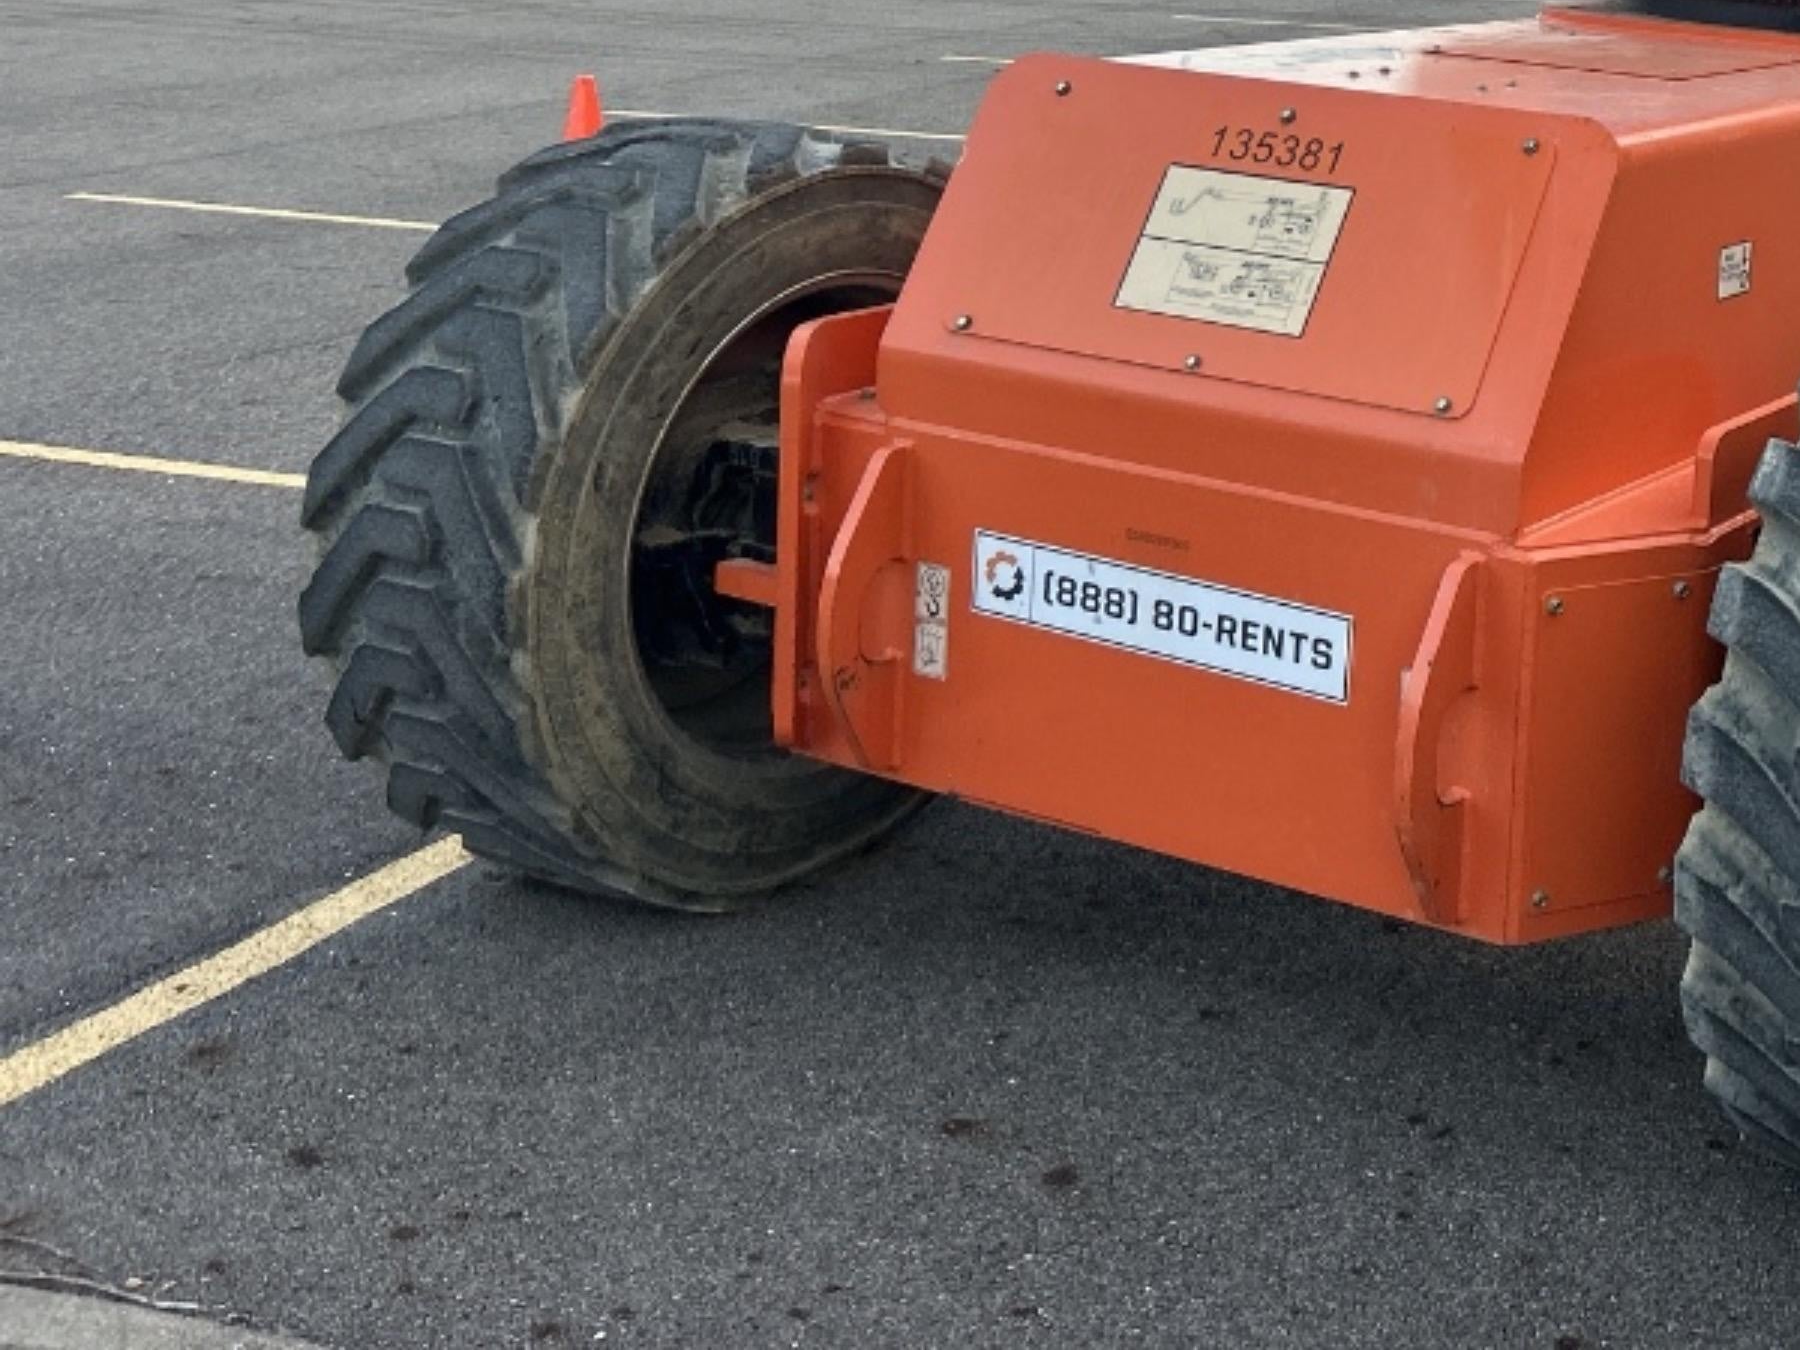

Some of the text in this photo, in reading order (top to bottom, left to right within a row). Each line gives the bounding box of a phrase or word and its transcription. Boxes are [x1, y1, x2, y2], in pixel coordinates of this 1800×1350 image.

[1211, 124, 1345, 175] 135381
[1042, 568, 1335, 672] (888) 80-RENTS
